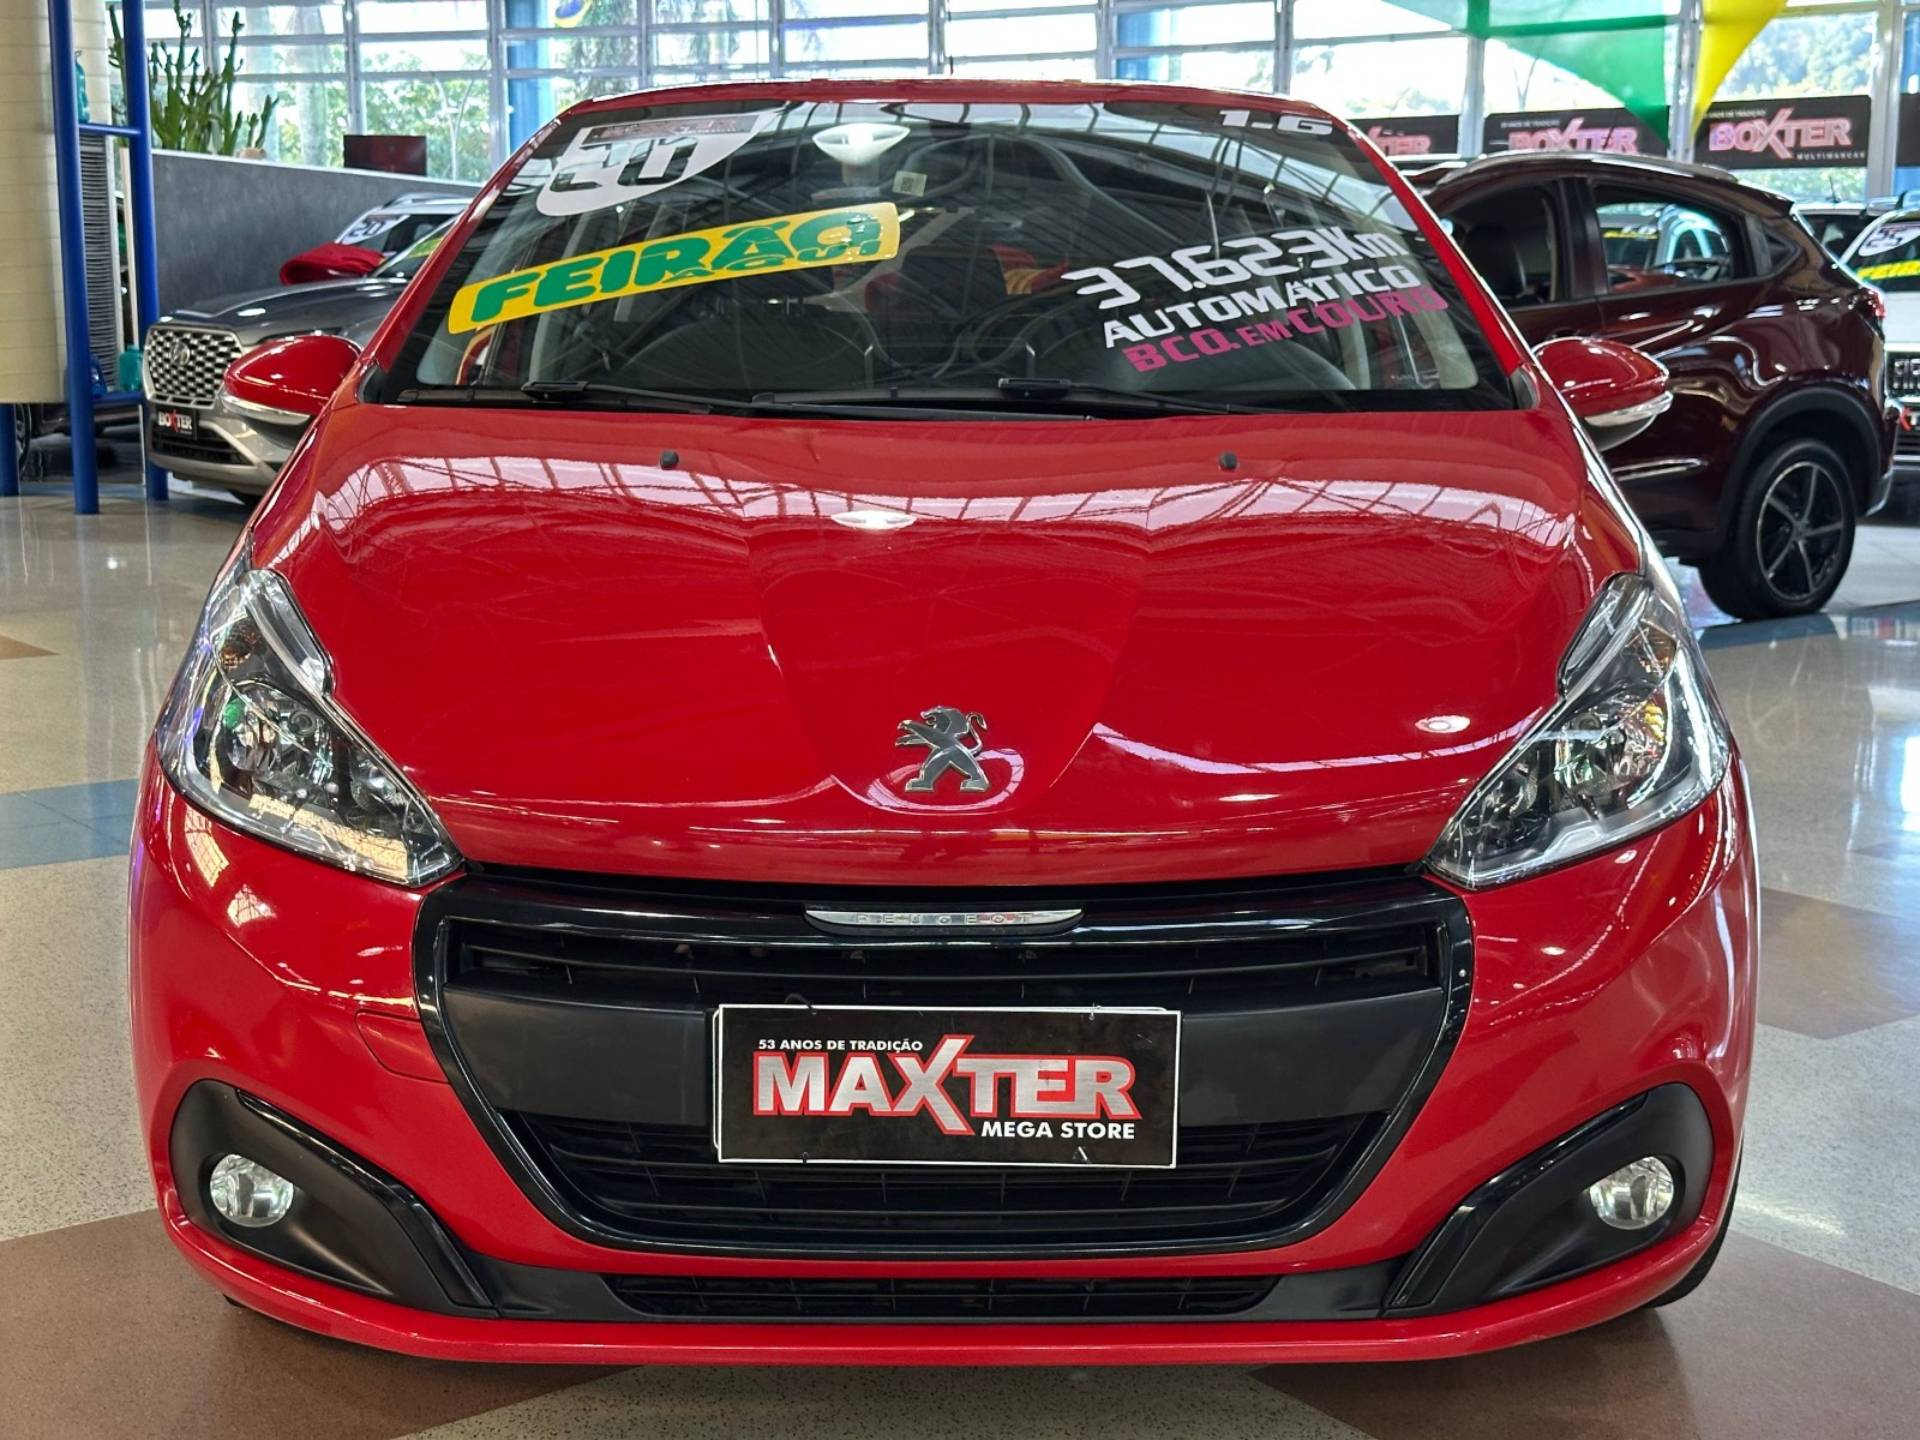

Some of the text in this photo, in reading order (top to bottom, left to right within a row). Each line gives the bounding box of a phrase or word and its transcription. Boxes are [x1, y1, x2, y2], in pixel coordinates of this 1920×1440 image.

[1219, 109, 1334, 136] 1.6
[1709, 107, 1852, 159] BOXTER
[470, 211, 882, 323] FEIRÃO
[1103, 265, 1422, 349] AUTOMÁTICO
[1235, 319, 1294, 347] EM
[1286, 286, 1450, 335] COURO
[758, 1038, 924, 1054] 53 ANOS DE TRADIÇÃO
[753, 1034, 1143, 1136] MAXTER
[981, 1120, 1136, 1140] MEGA STORE
